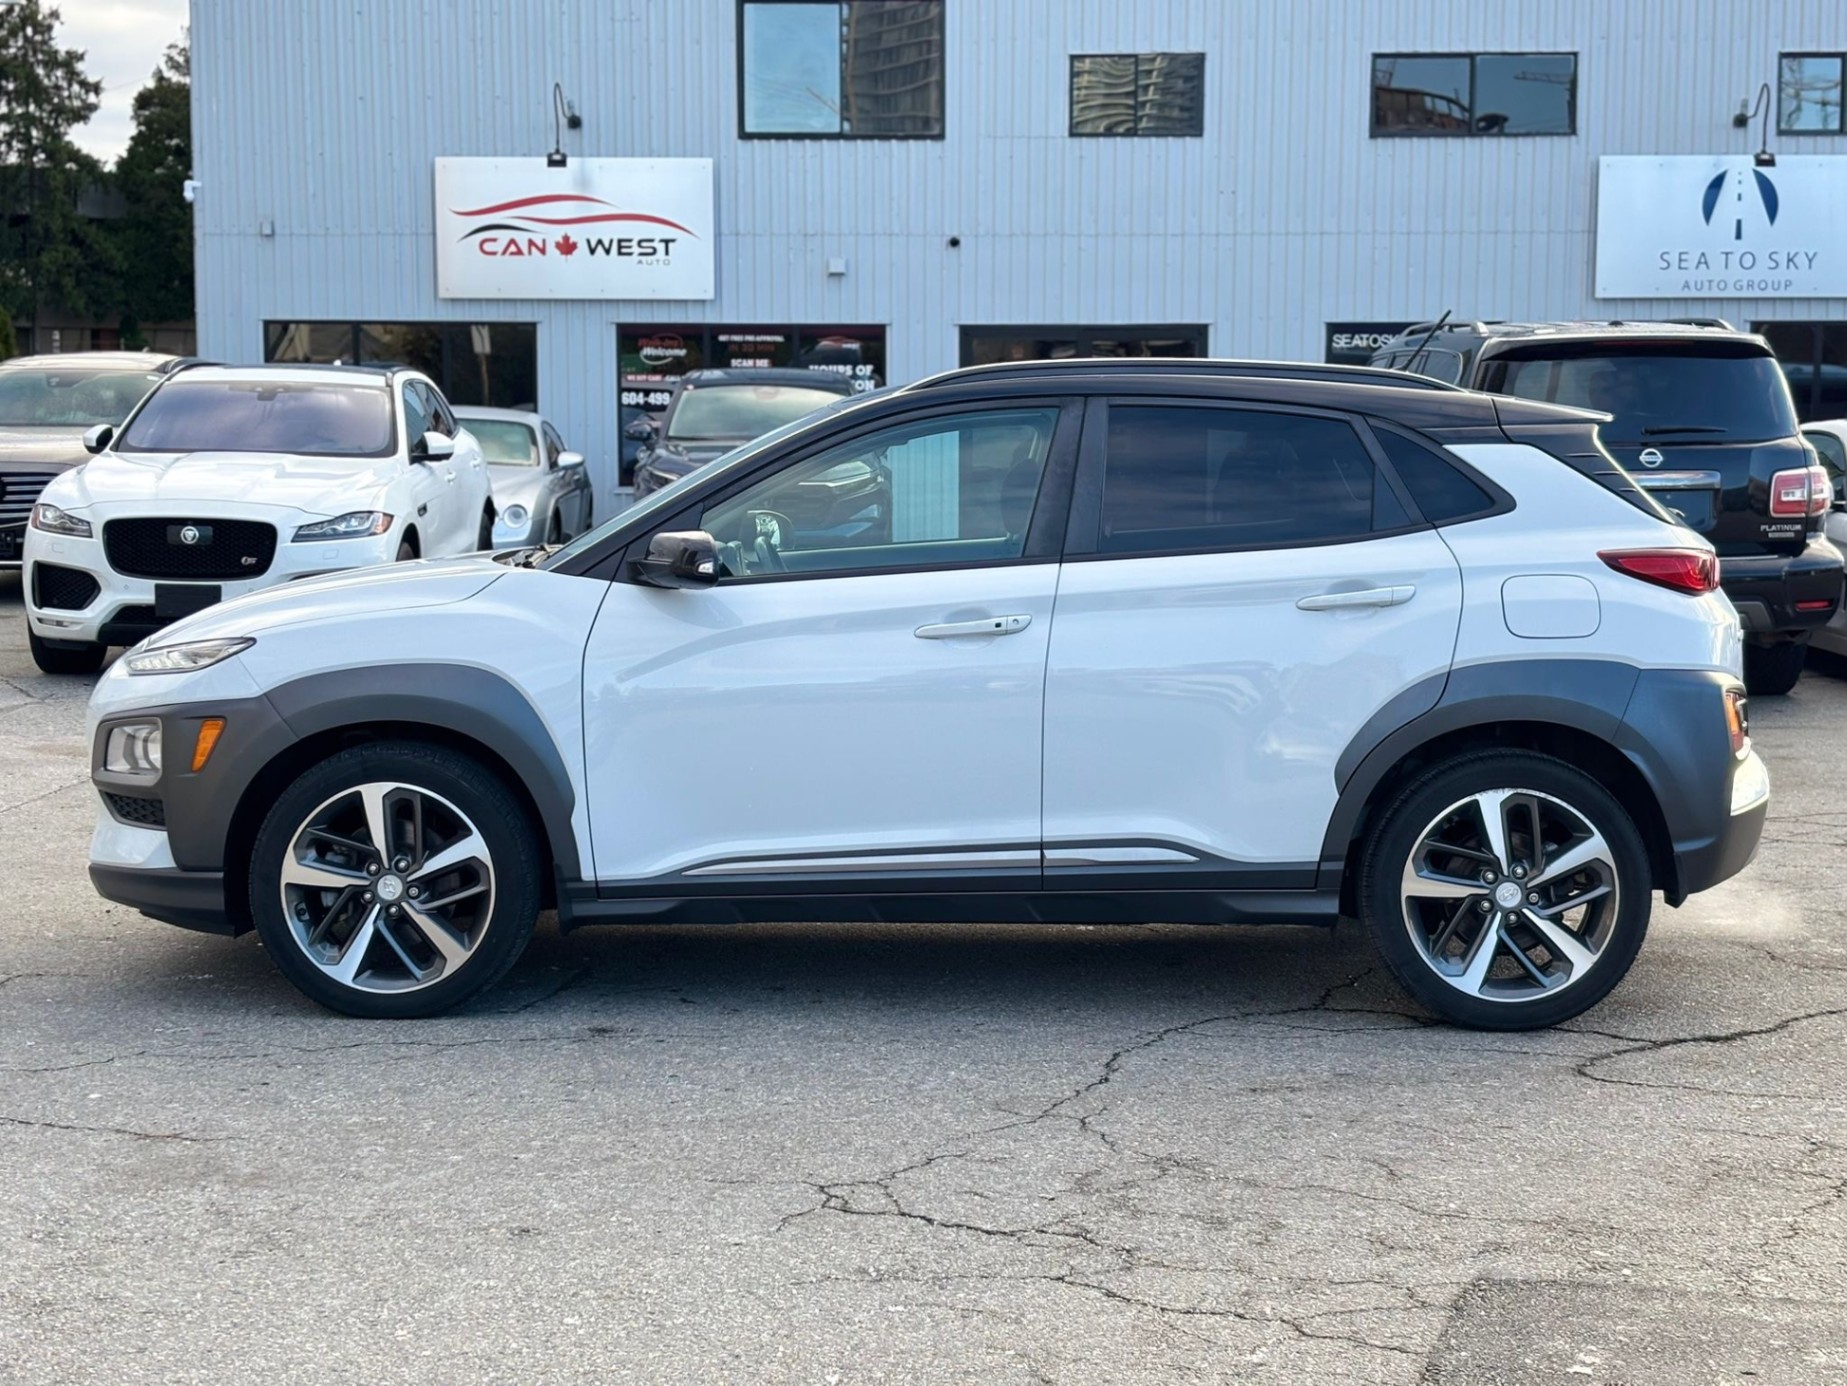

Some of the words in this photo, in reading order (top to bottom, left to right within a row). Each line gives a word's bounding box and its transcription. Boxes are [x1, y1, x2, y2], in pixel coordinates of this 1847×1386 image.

[478, 238, 546, 256] CAN
[586, 238, 678, 256] WEST
[1659, 251, 1710, 270] SEA
[1721, 251, 1756, 270] TO
[1768, 251, 1818, 270] SKY
[1681, 280, 1728, 291] AUTO
[1733, 280, 1793, 291] GROUP
[730, 358, 754, 368] SCAN
[855, 364, 874, 376] OF
[621, 391, 670, 405] 604-499
[1760, 524, 1802, 532] PLATINUM
